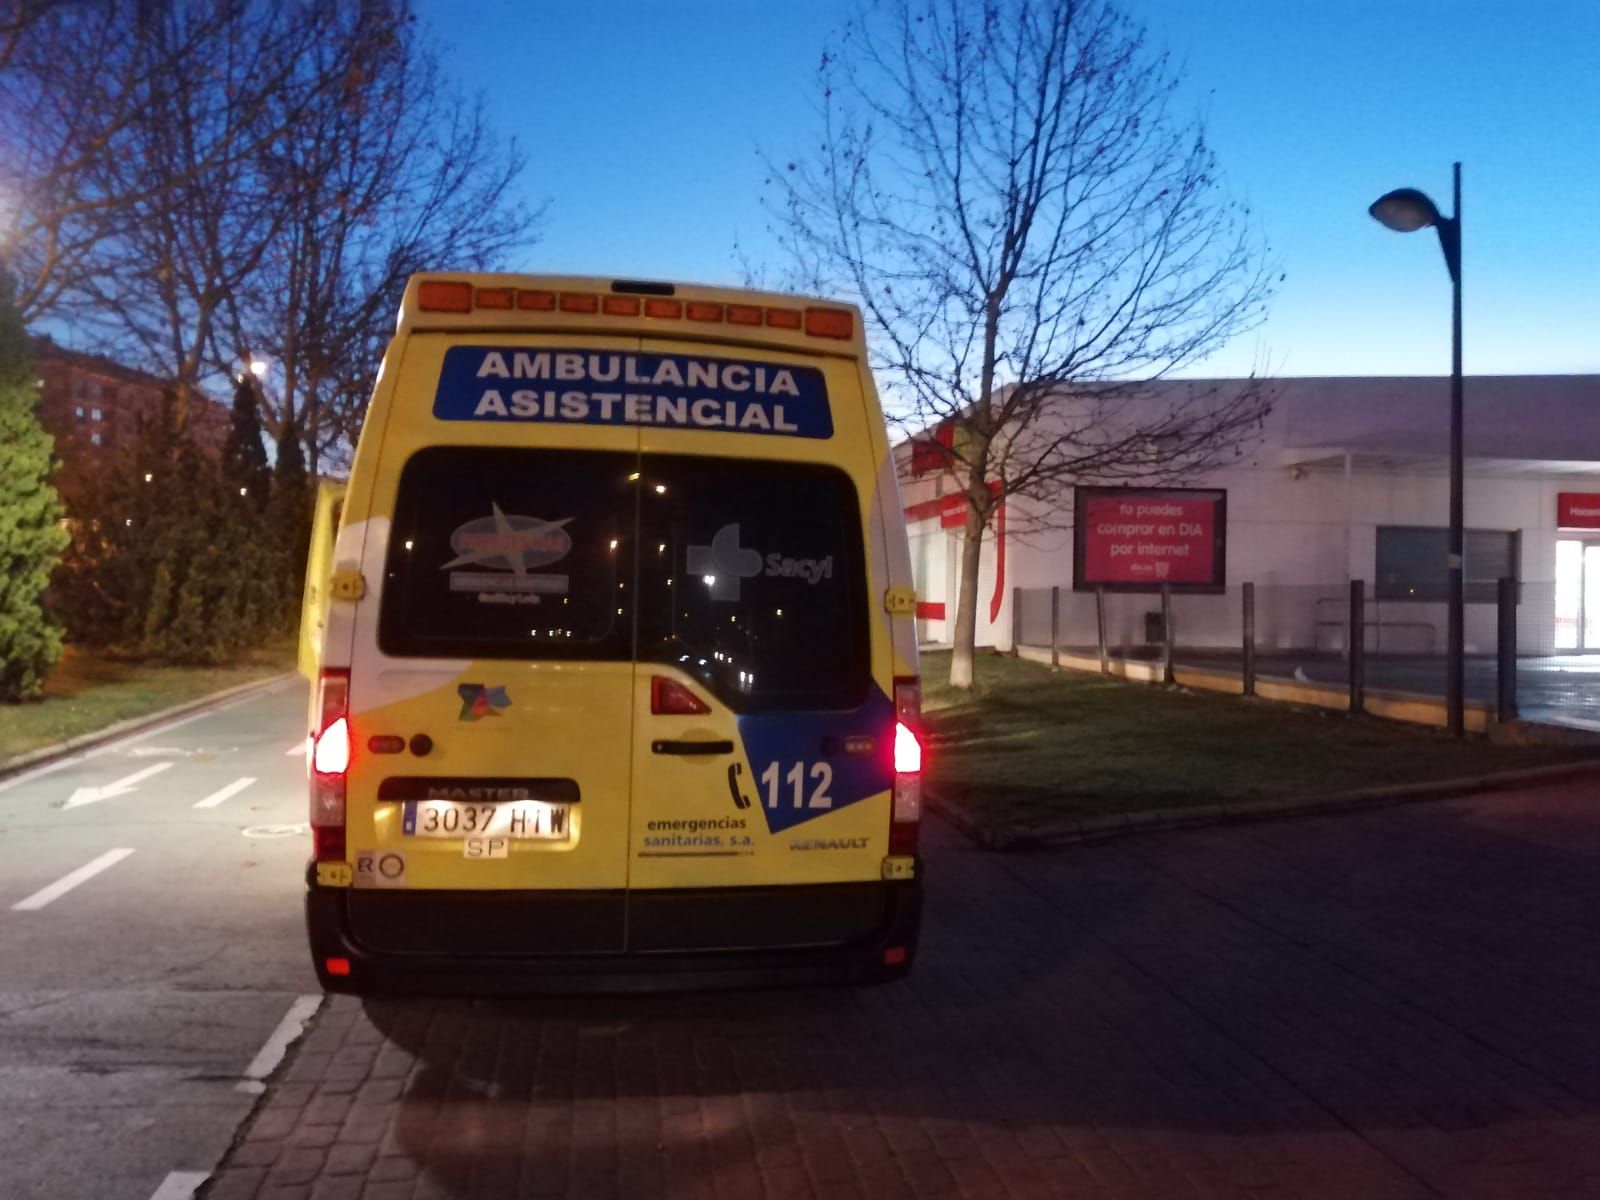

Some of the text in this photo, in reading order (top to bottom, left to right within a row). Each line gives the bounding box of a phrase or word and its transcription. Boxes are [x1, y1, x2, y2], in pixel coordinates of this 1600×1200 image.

[476, 352, 800, 396] AMBULANCIA
[474, 390, 798, 432] ASISTENCIAL
[1136, 504, 1183, 518] puedes
[1097, 523, 1203, 538] comprar en DIA
[1110, 541, 1189, 557] por internet
[765, 553, 832, 584] Sacyl
[761, 761, 833, 808] 112
[428, 787, 529, 800] MASTER
[424, 807, 496, 832] 3037
[647, 816, 746, 832] emergencias
[467, 839, 504, 856] SP
[789, 837, 870, 851] RENAULT
